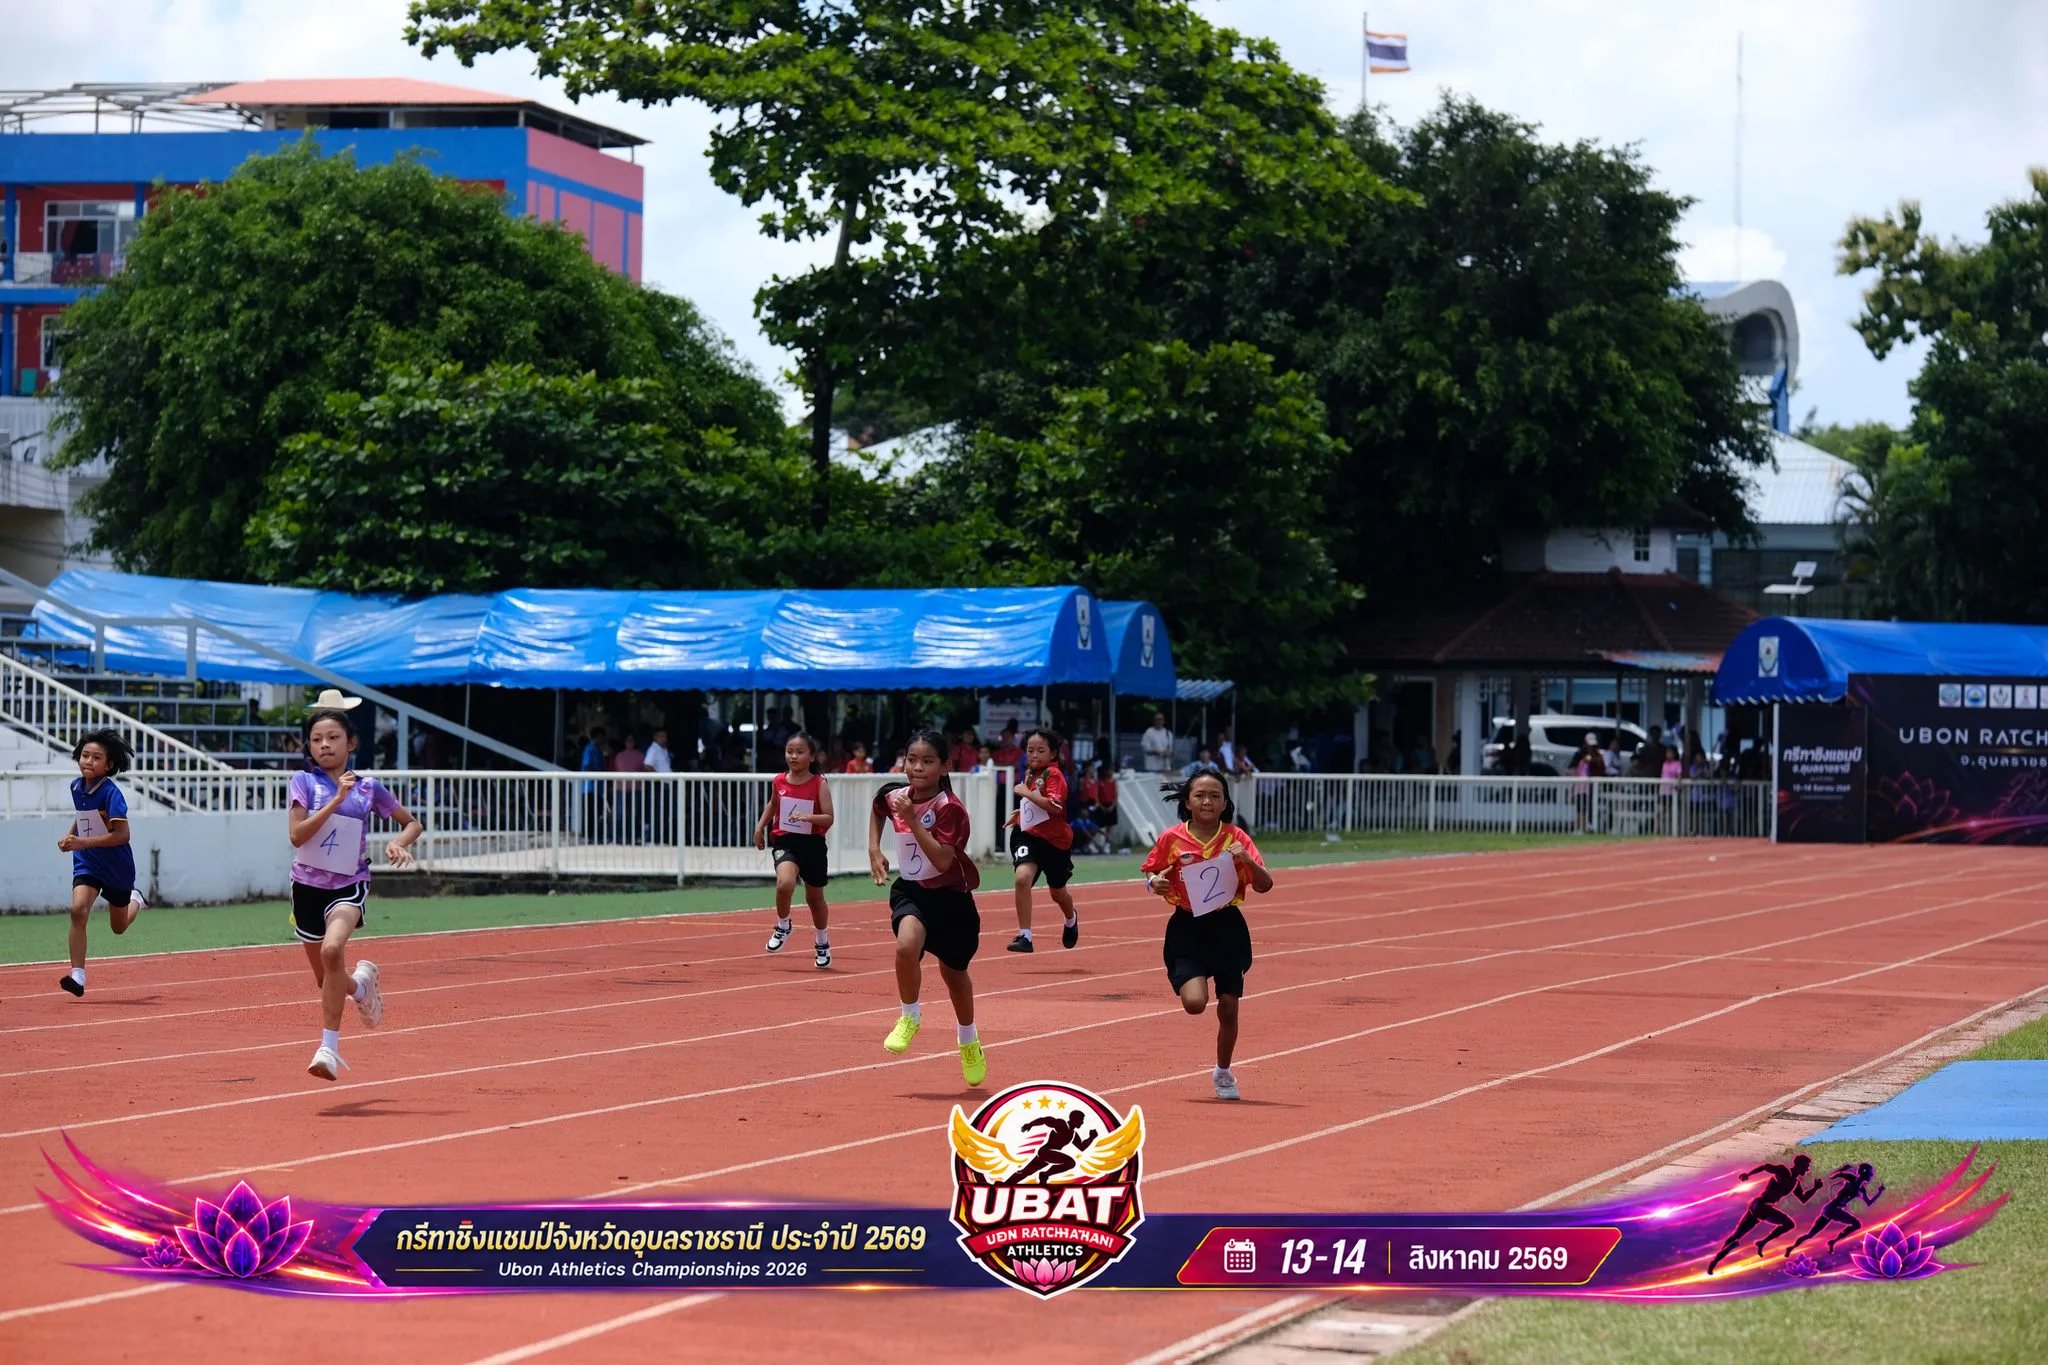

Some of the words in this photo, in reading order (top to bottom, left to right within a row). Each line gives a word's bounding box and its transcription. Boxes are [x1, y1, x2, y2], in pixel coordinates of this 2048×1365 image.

[1899, 727, 1968, 745] UBON
[1023, 800, 1034, 824] 5
[79, 818, 93, 838] 7
[320, 828, 339, 856] 4
[905, 842, 923, 876] 3
[1200, 866, 1226, 903] 2
